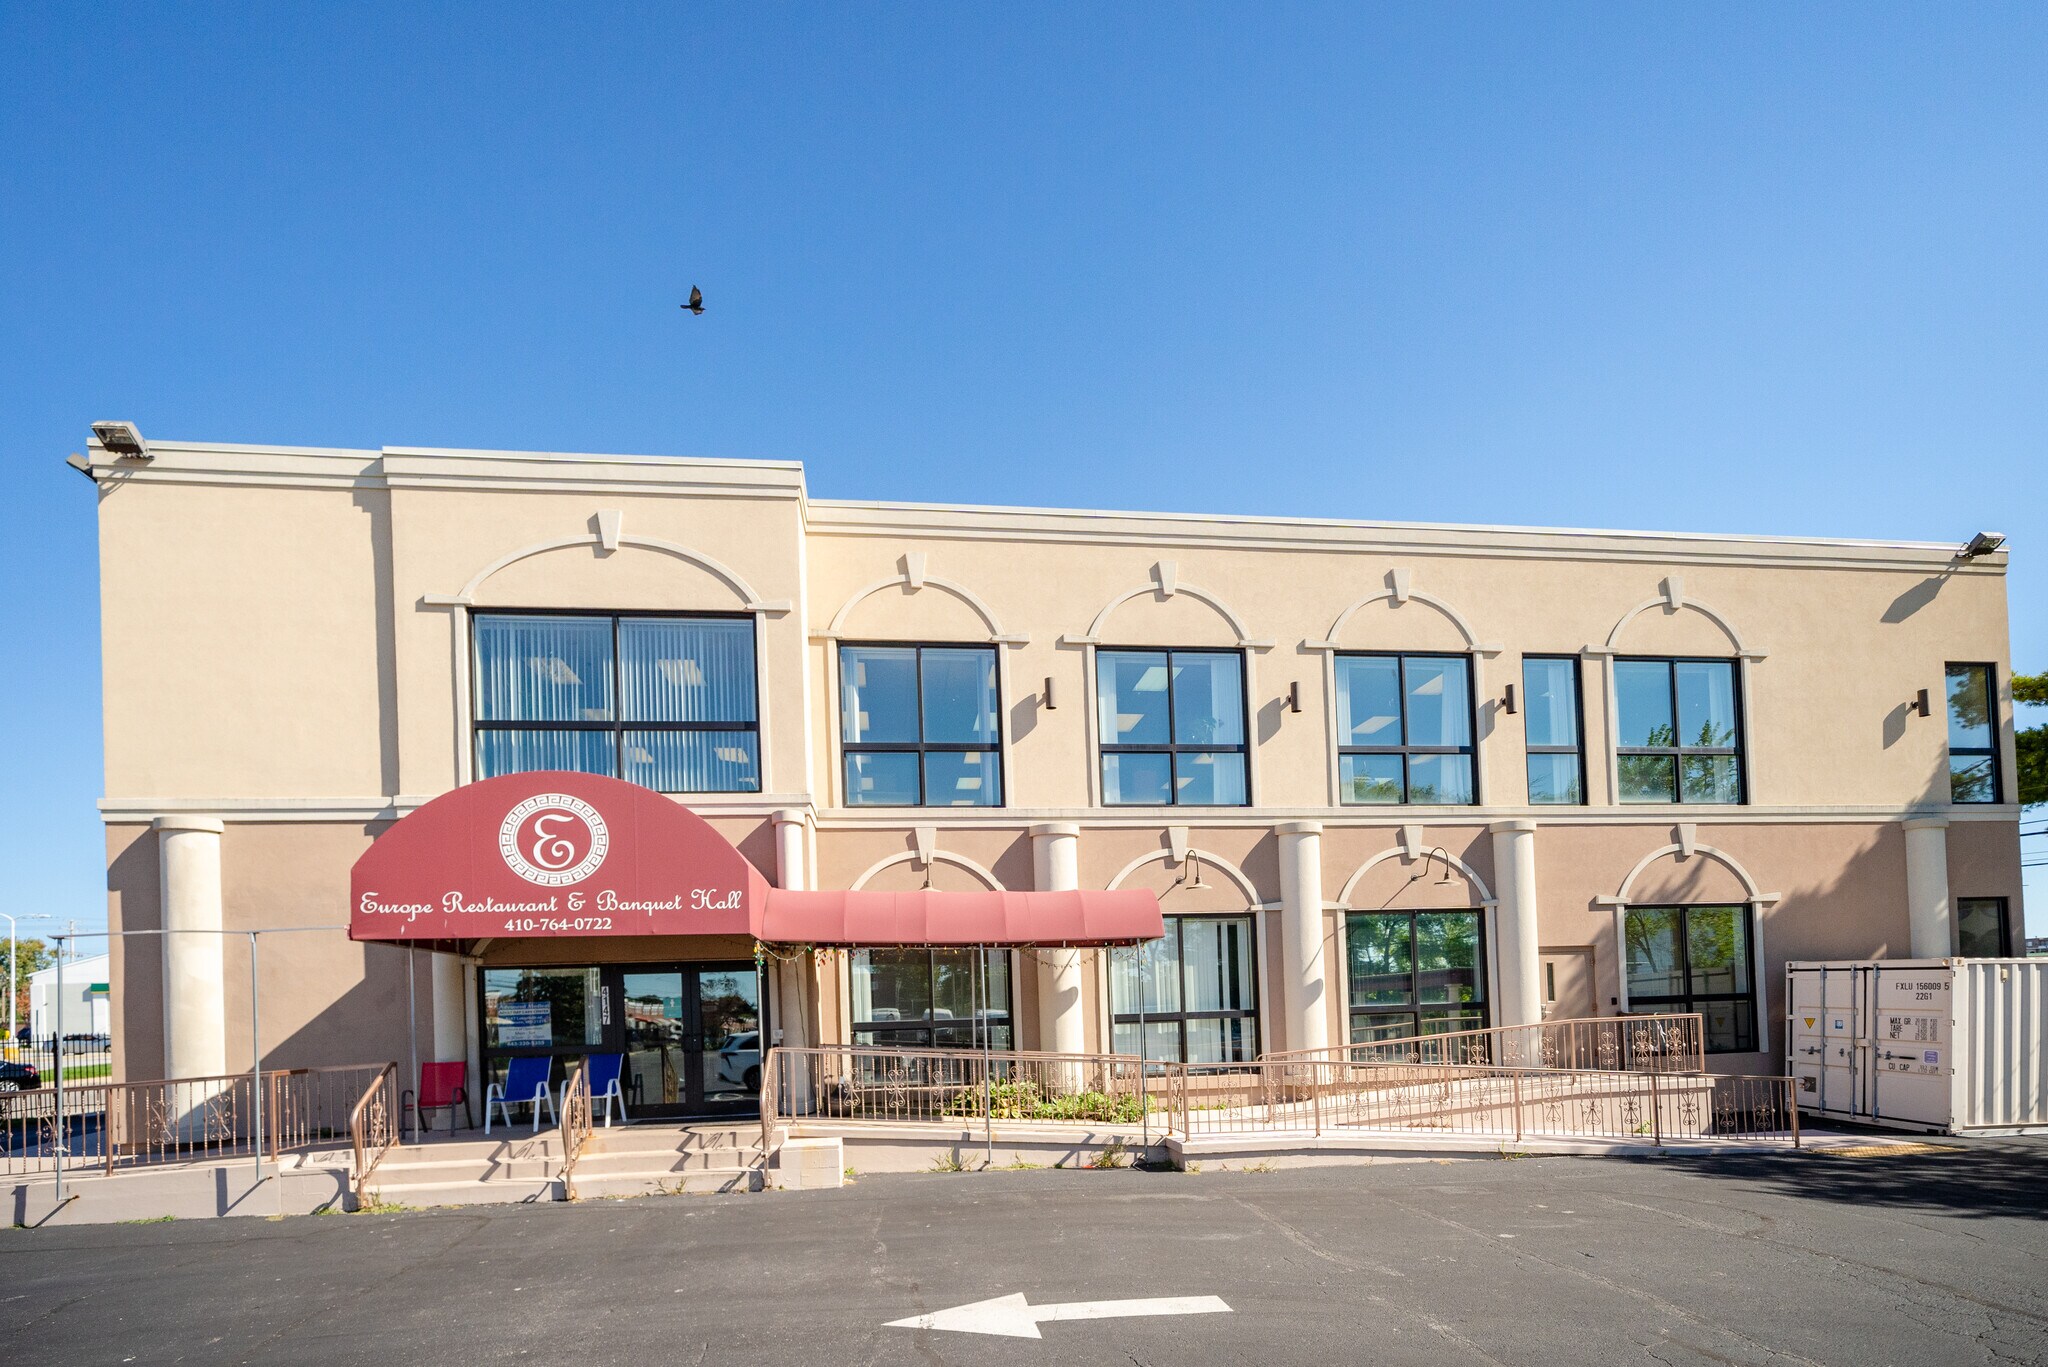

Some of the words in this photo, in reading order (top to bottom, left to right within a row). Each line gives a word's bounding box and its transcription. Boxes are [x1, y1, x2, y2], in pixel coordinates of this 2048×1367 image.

[359, 891, 433, 922] Europe
[441, 891, 558, 913] Restaurant
[567, 891, 586, 911] &
[596, 889, 682, 916] Banquet
[690, 888, 742, 910] Hall
[504, 917, 612, 931] 410-764-0722
[1895, 982, 1913, 991] FXLU
[1916, 982, 1941, 991] 156009
[1944, 982, 1950, 991] 5
[1915, 992, 1932, 1000] 22G1
[1889, 1017, 1901, 1025] MAX
[1890, 1024, 1903, 1032] TARE
